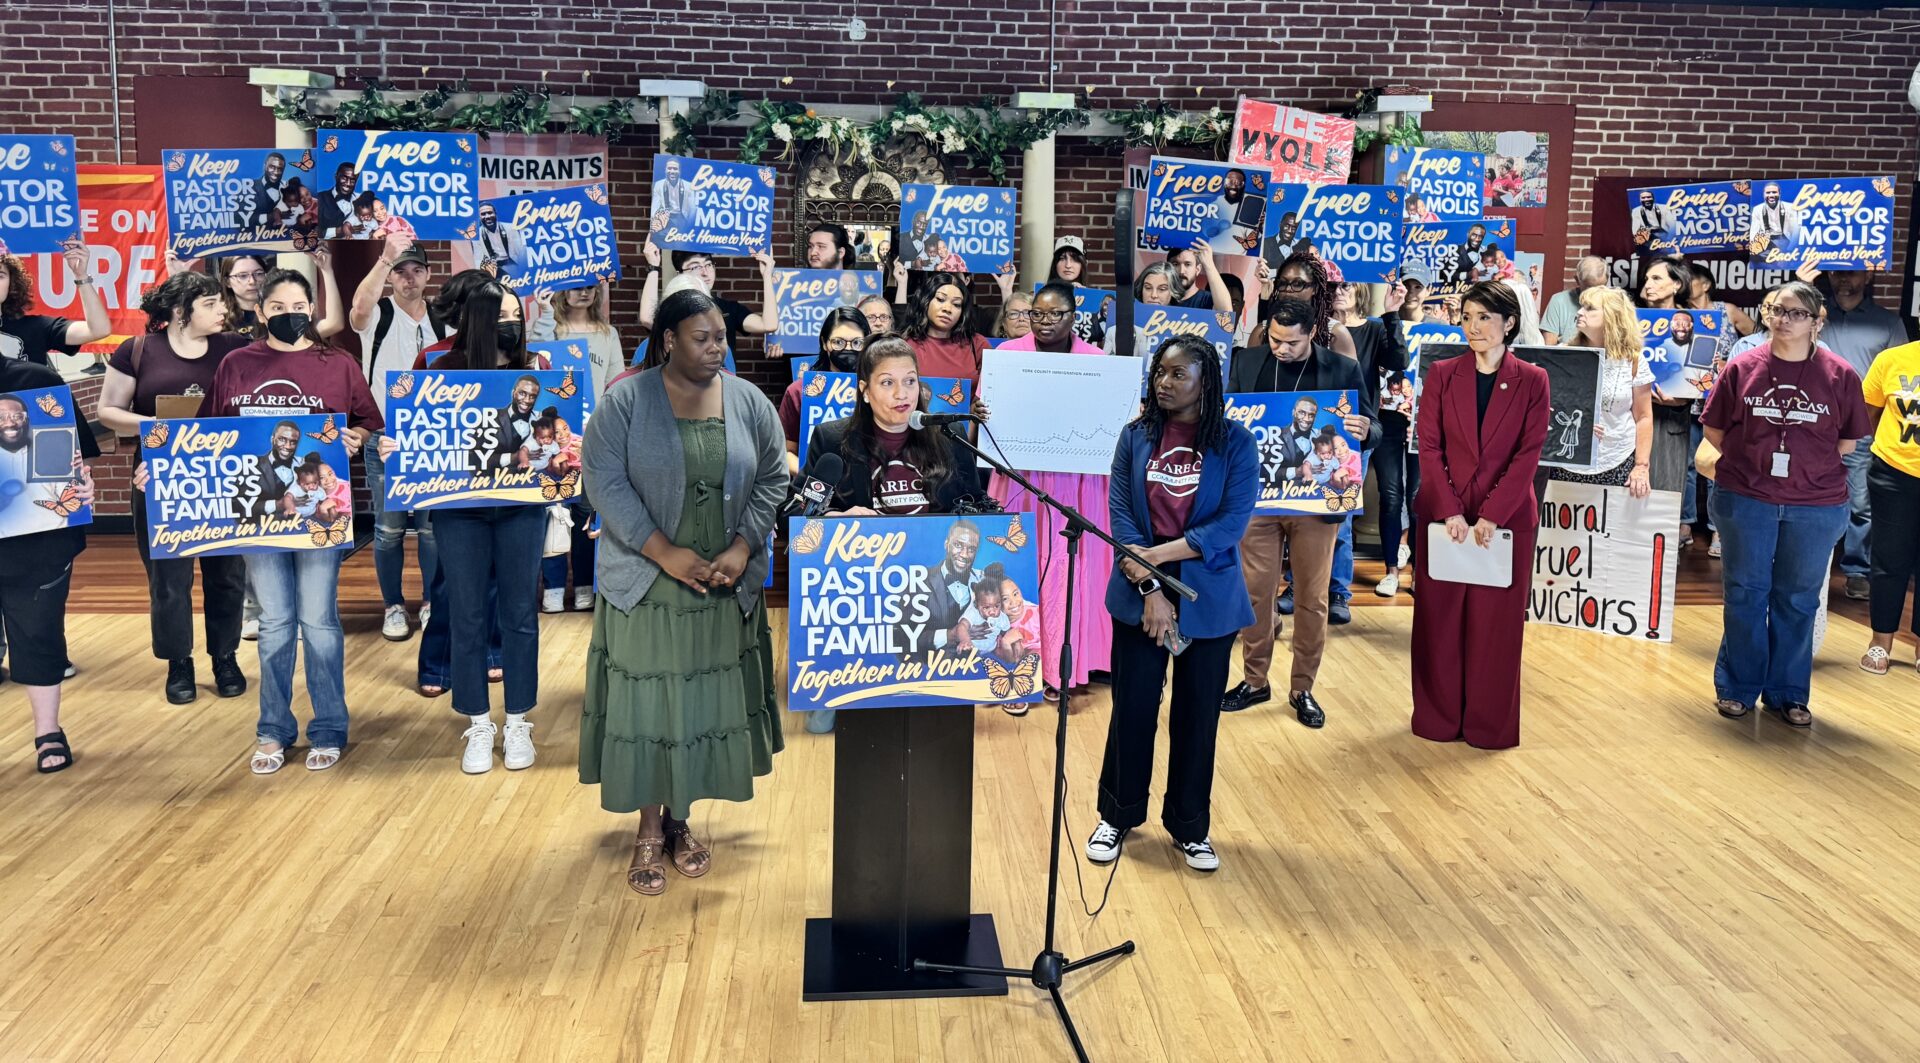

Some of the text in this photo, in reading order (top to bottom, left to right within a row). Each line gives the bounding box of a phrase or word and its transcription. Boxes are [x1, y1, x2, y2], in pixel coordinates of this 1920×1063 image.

[1273, 105, 1326, 143] ICE
[354, 129, 440, 175] Free
[1406, 148, 1460, 179] Free
[187, 154, 239, 182] Keep
[481, 156, 603, 180] MIGRANTS
[1157, 164, 1223, 196] Free
[0, 179, 68, 202] TOR
[172, 178, 256, 197] PASTOR
[362, 171, 468, 193] PASTOR
[691, 165, 752, 201] Bring
[1411, 178, 1477, 198] PASTOR
[173, 196, 258, 215] MOLIS'S
[387, 194, 475, 218] MOLIS
[695, 189, 770, 214] PASTOR
[927, 185, 989, 221] Free
[1150, 197, 1219, 219] PASTOR
[1295, 184, 1371, 221] Free
[1426, 197, 1480, 216] MOLIS
[1667, 183, 1728, 212] Bring
[1792, 183, 1865, 216] Bring
[0, 204, 74, 229] OLIS
[80, 209, 156, 233] E ON
[179, 212, 254, 231] FAMILY
[512, 197, 582, 230] Bring
[694, 208, 768, 233] MOLIS
[1148, 213, 1202, 233] MOLIS
[1674, 203, 1750, 220] PASTOR
[1797, 207, 1890, 226] PASTOR
[521, 216, 610, 245] PASTOR
[665, 227, 765, 247] Back Home to York
[930, 217, 1007, 236] PASTOR
[1301, 219, 1393, 241] PASTOR
[1406, 225, 1448, 248] Keep
[1675, 216, 1750, 236] MOLIS
[1799, 225, 1886, 246] MOLIS
[172, 224, 288, 255] Together in York
[527, 234, 611, 268] MOLIS
[948, 237, 1011, 256] MOLIS
[1649, 232, 1750, 252] Back Home to York
[1322, 242, 1396, 263] MOLIS
[1766, 245, 1886, 263] Back Home to York
[15, 245, 155, 310] URE
[534, 267, 570, 285] Home
[571, 264, 582, 277] to
[582, 256, 612, 276] York
[777, 271, 838, 304] Free
[778, 306, 836, 321] ASTO
[1143, 309, 1209, 338] Bring
[1638, 317, 1669, 338] ee
[231, 394, 324, 409] WE ARE CASA
[415, 374, 481, 410] Keep
[825, 377, 857, 406] Ke
[1744, 397, 1763, 406] WE
[395, 408, 500, 430] PASTOR
[1225, 397, 1266, 429] eep
[171, 422, 239, 457] Keep
[396, 429, 499, 452] MOLIS'S
[152, 455, 260, 480] PASTOR
[399, 450, 496, 473] FAMILY
[1163, 463, 1191, 475] ARE
[154, 475, 262, 501] MOLIS'S
[388, 467, 537, 505] Together in York
[1261, 479, 1321, 500] in York
[161, 497, 258, 522] FAMILY
[1541, 489, 1610, 538] moral,
[152, 513, 304, 553] Together in York
[824, 520, 907, 569] Keep
[1536, 535, 1593, 579] ruel
[800, 564, 931, 596] PASTOR
[800, 594, 931, 627] MOLIS'S
[1525, 581, 1637, 636] victors
[807, 623, 926, 656] FAMILY
[792, 648, 982, 701] Together in York
